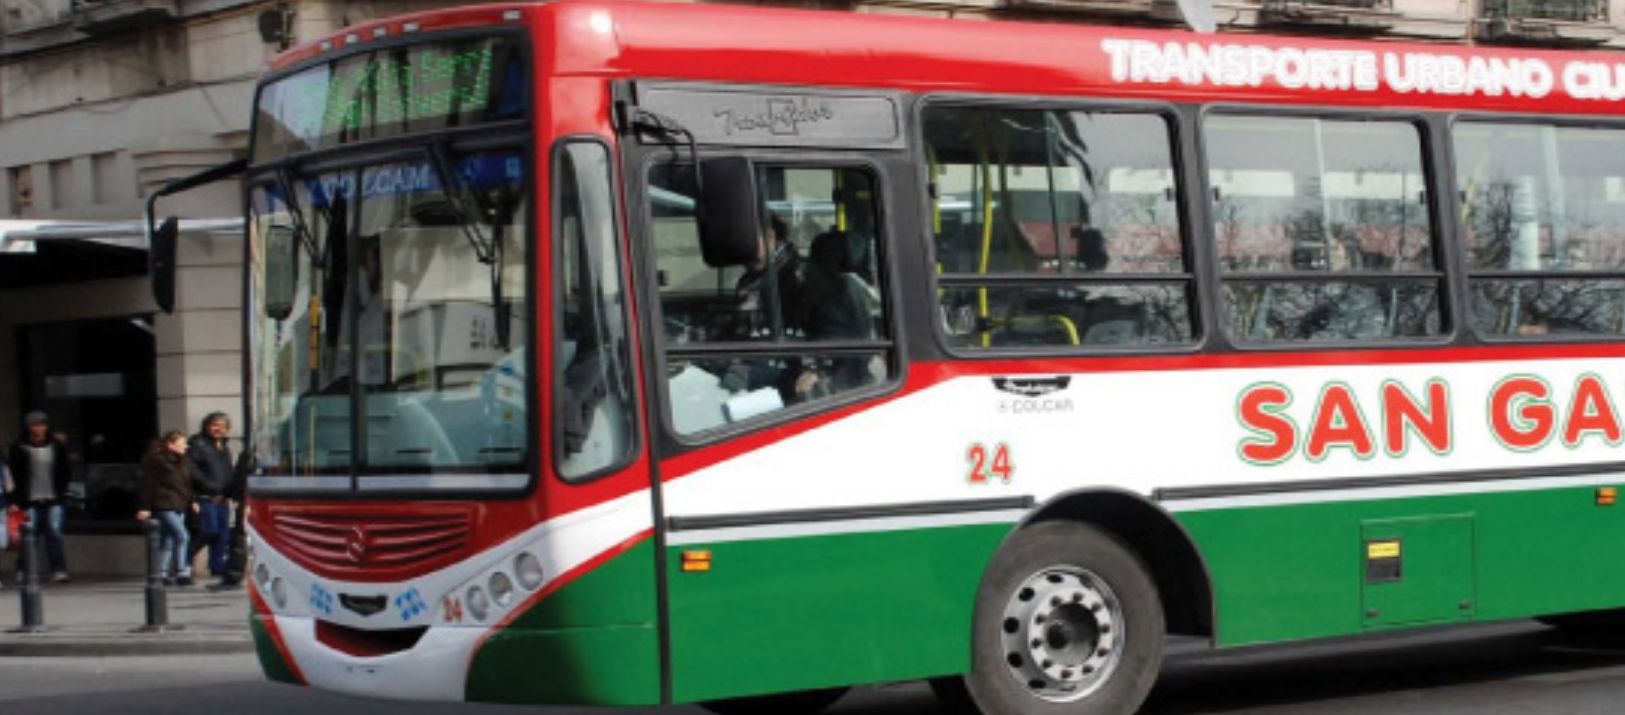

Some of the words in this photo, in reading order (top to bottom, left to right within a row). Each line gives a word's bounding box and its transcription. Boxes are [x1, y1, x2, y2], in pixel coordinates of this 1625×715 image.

[1105, 39, 1378, 89] TRANSPORTE
[1384, 52, 1553, 98] URBANO
[1235, 378, 1453, 465] SAN
[1486, 371, 1625, 453] GA
[968, 442, 1012, 484] 24
[442, 598, 465, 623] 24
